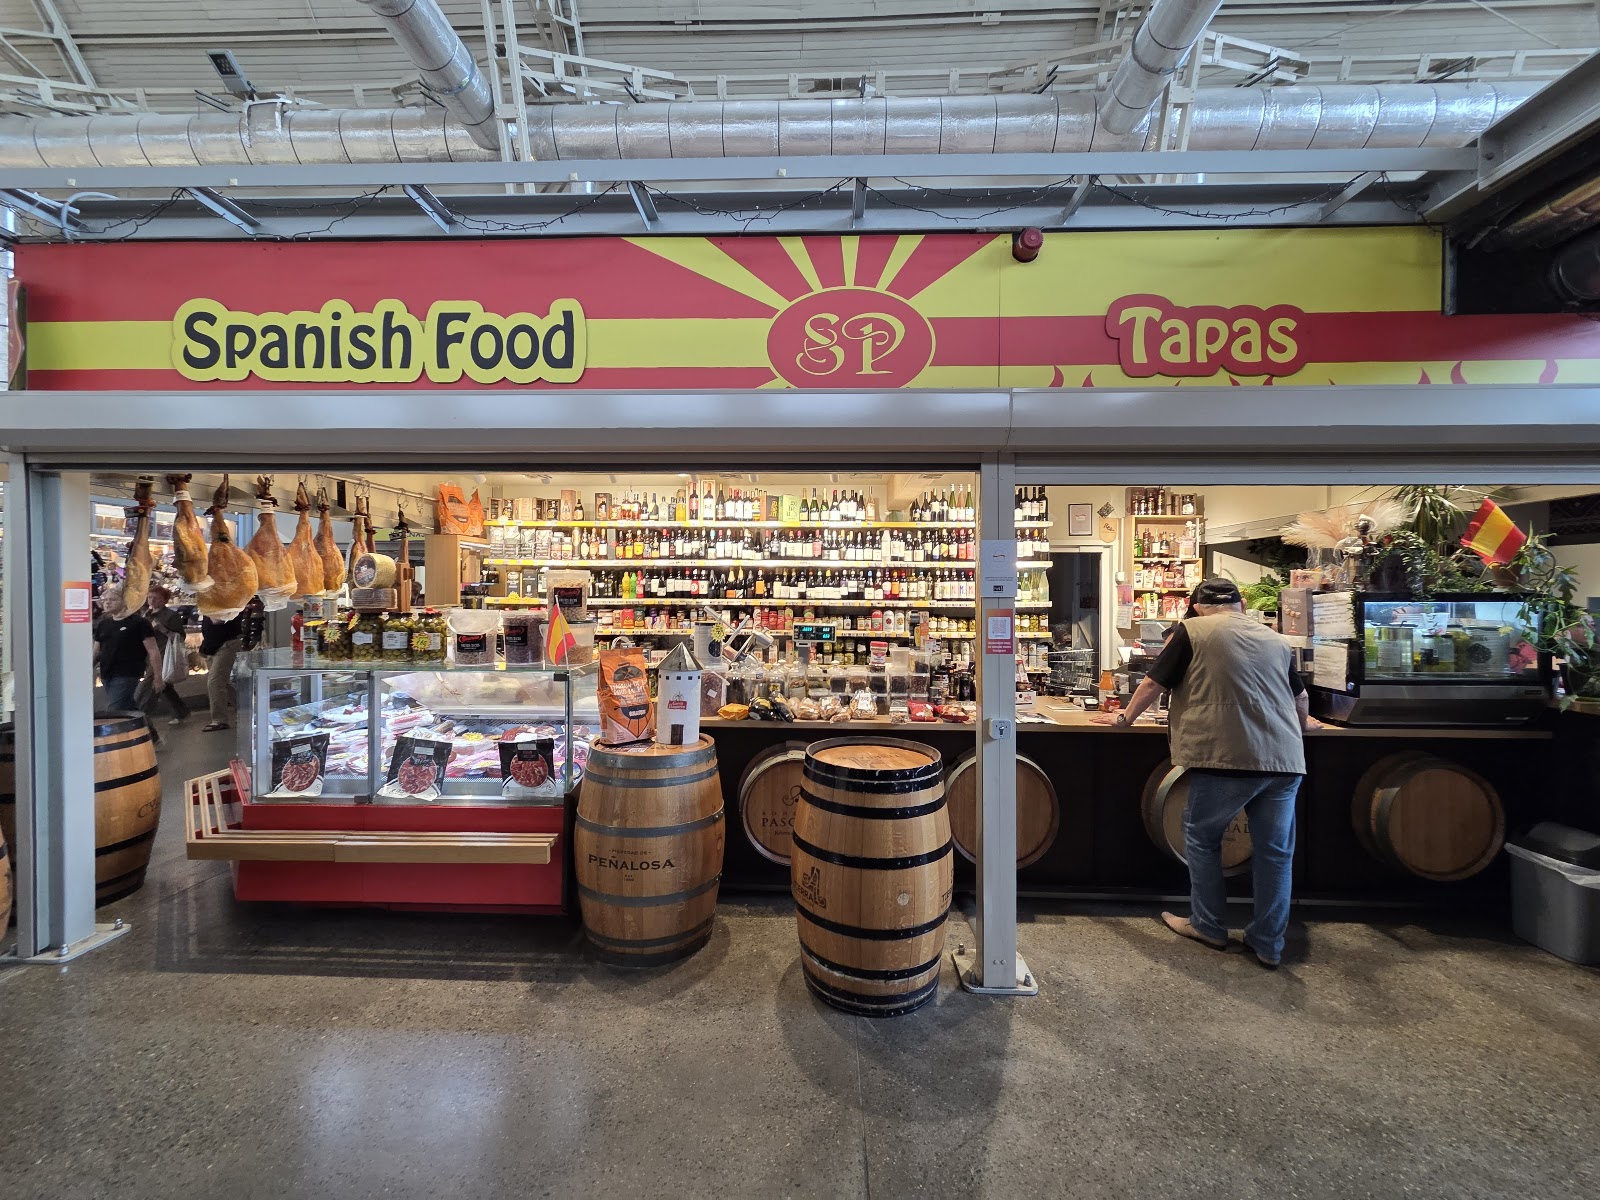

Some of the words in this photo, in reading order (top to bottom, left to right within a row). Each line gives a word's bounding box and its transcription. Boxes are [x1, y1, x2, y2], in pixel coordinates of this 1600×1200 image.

[183, 311, 412, 370] Spanish
[437, 310, 574, 370] Food
[796, 312, 906, 376] SP
[1119, 306, 1298, 364] Tapas
[588, 853, 675, 871] PEÑALOSA
